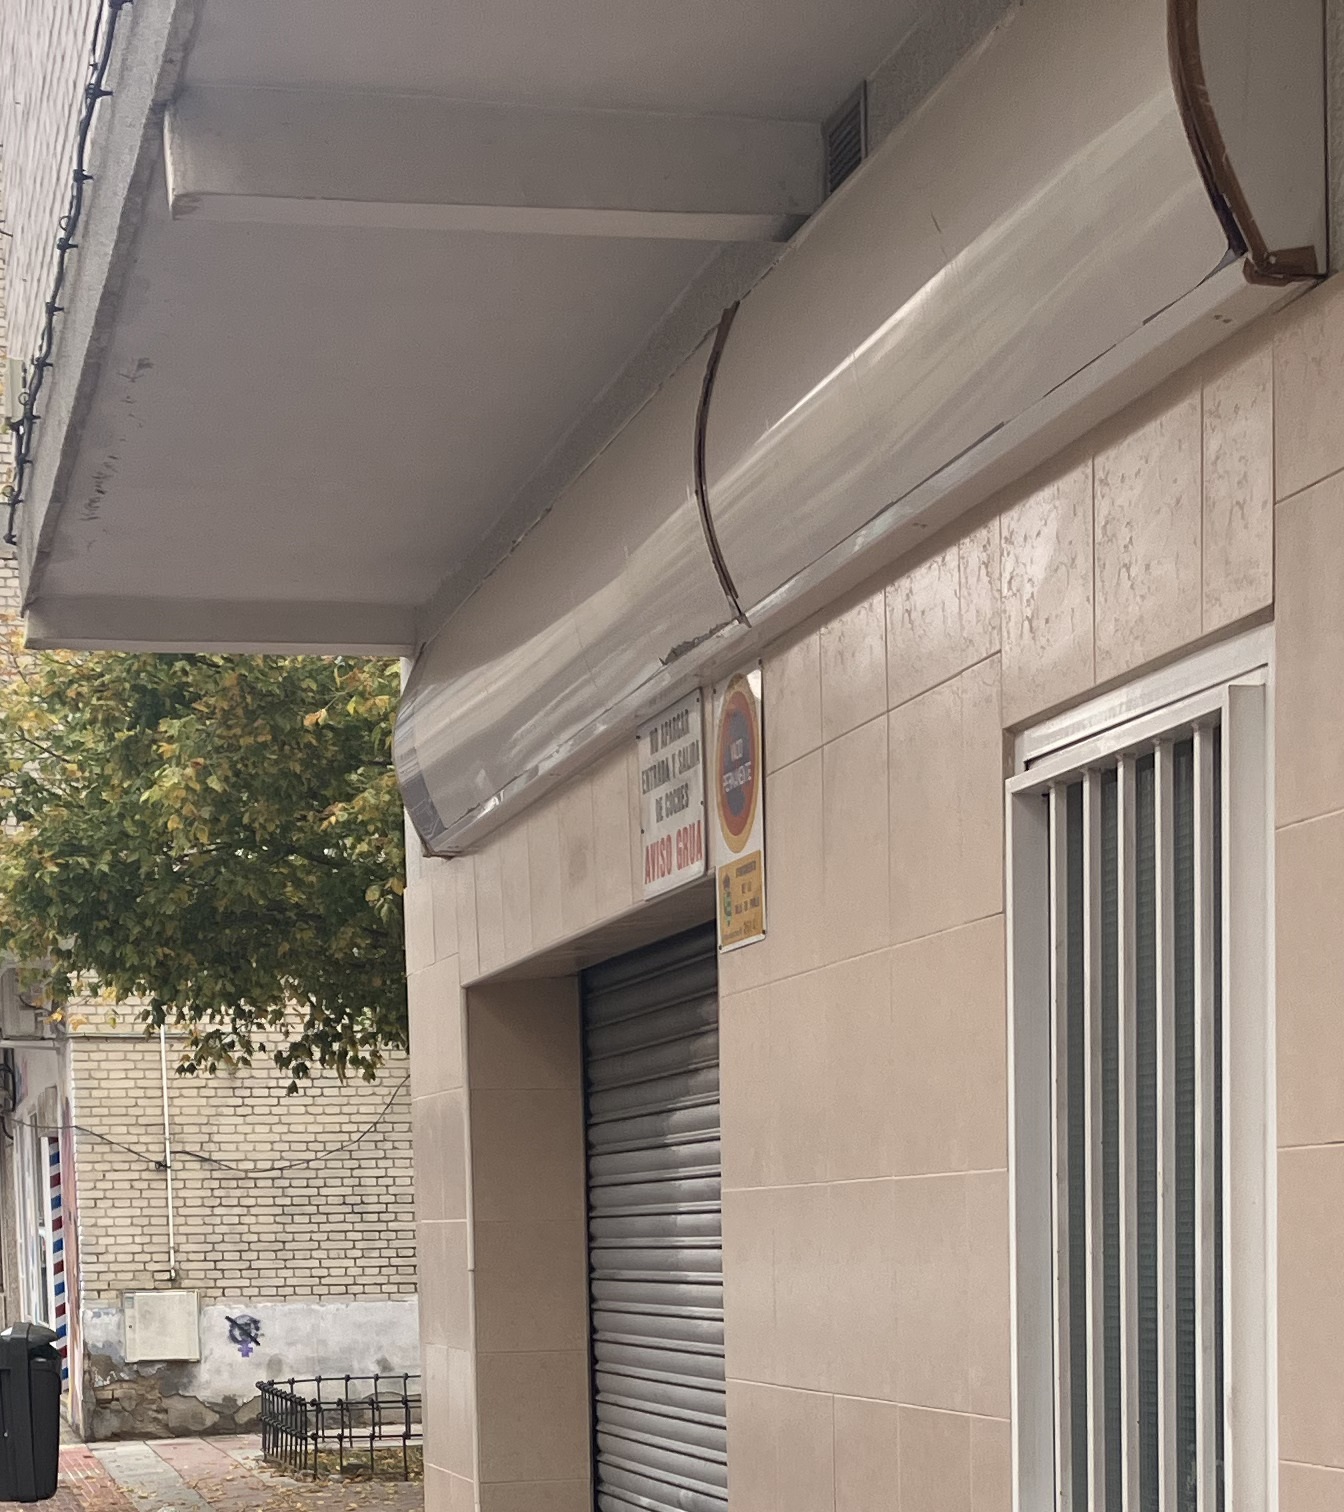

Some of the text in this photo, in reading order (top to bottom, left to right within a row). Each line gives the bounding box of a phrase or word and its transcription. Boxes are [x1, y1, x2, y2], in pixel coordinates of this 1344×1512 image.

[641, 757, 671, 795] ENTRADA
[678, 739, 701, 775] SALIDA
[655, 782, 690, 823] DE COCHES
[644, 819, 703, 885] AVISO GRUA
